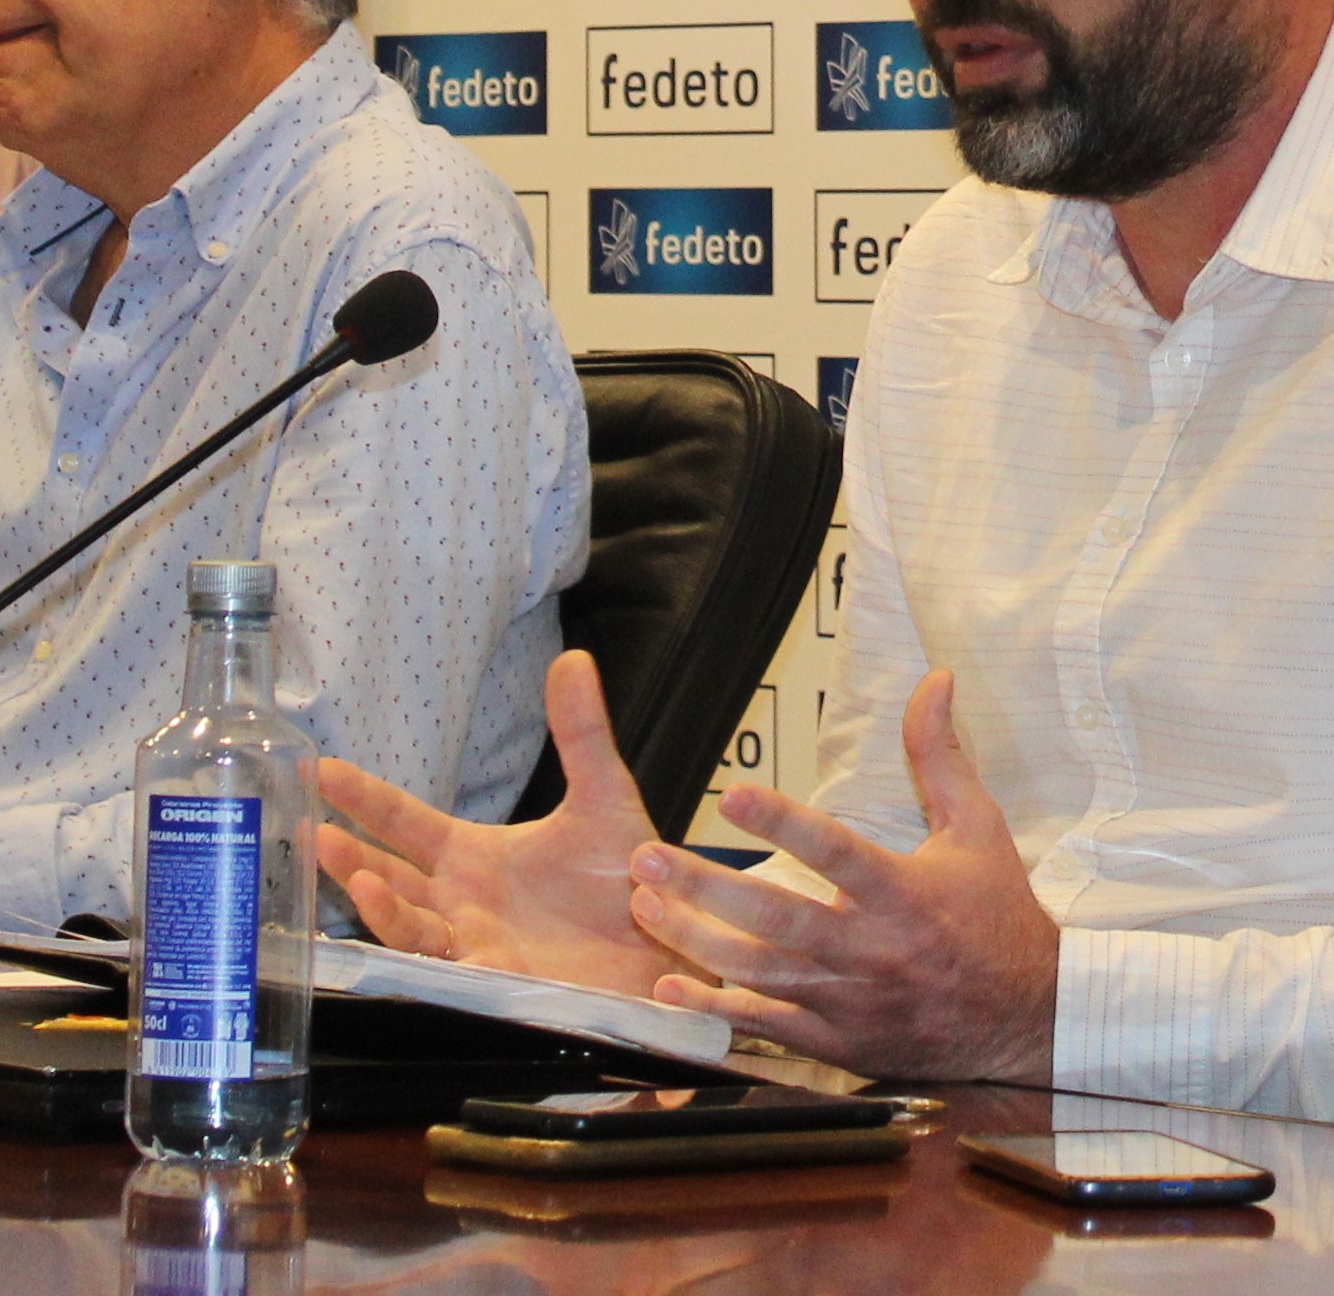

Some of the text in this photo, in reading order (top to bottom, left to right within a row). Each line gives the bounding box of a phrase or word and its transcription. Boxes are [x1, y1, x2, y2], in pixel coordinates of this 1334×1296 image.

[427, 65, 538, 108] fedeto
[601, 53, 759, 109] fedeto
[876, 54, 947, 101] fed
[645, 220, 763, 265] fedeto
[160, 808, 243, 823] ORIGEN
[185, 833, 210, 843] 100%
[211, 833, 257, 844] NATURAL
[144, 1015, 167, 1031] 50cl
